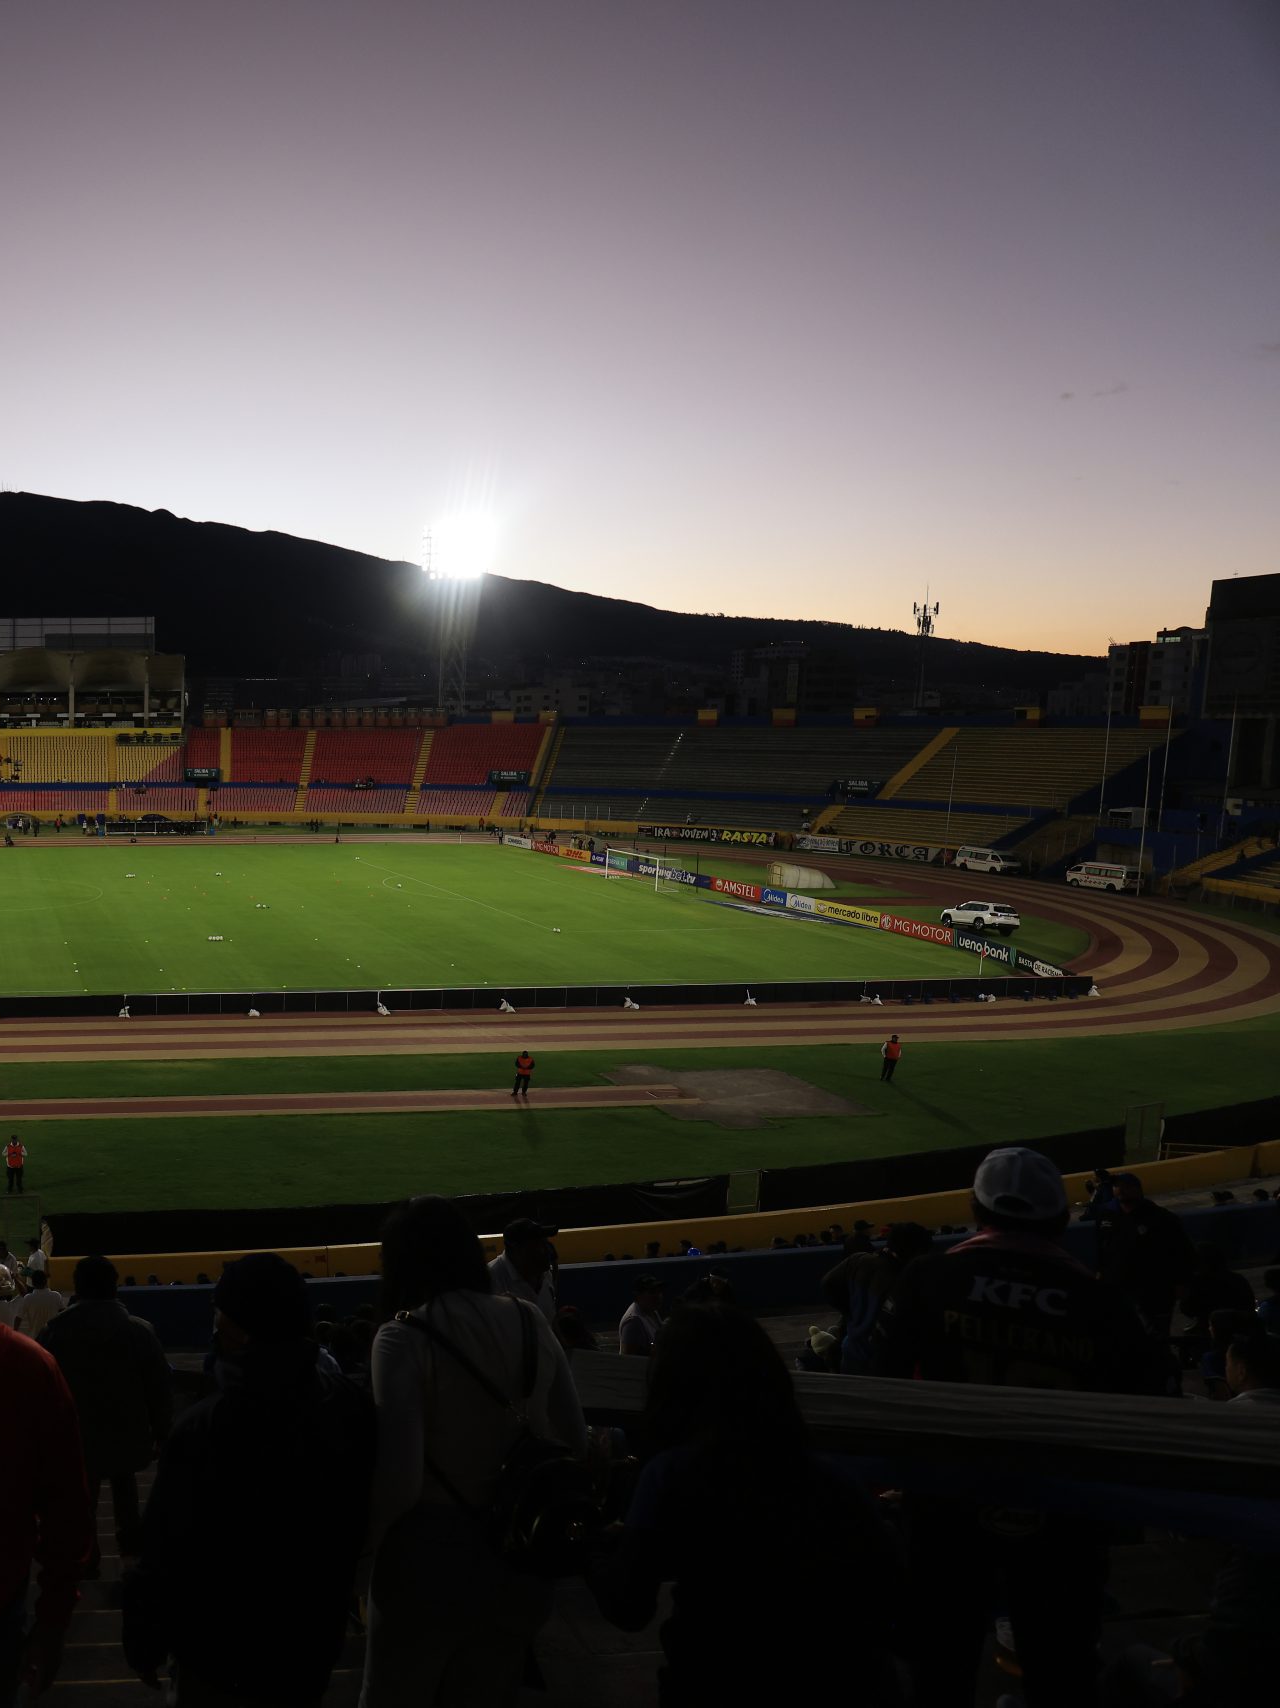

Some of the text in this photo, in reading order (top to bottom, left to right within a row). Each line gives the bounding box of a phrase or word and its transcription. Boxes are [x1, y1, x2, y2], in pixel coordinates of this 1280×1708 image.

[721, 830, 769, 843] RASTA
[723, 881, 755, 898] AMSTEL
[828, 905, 879, 924] mercado libre
[894, 918, 910, 933] MG
[912, 924, 951, 943] MOTOR
[959, 937, 1009, 962] ueno bank
[1018, 957, 1033, 968] BASTA
[968, 1275, 1069, 1318] KFC
